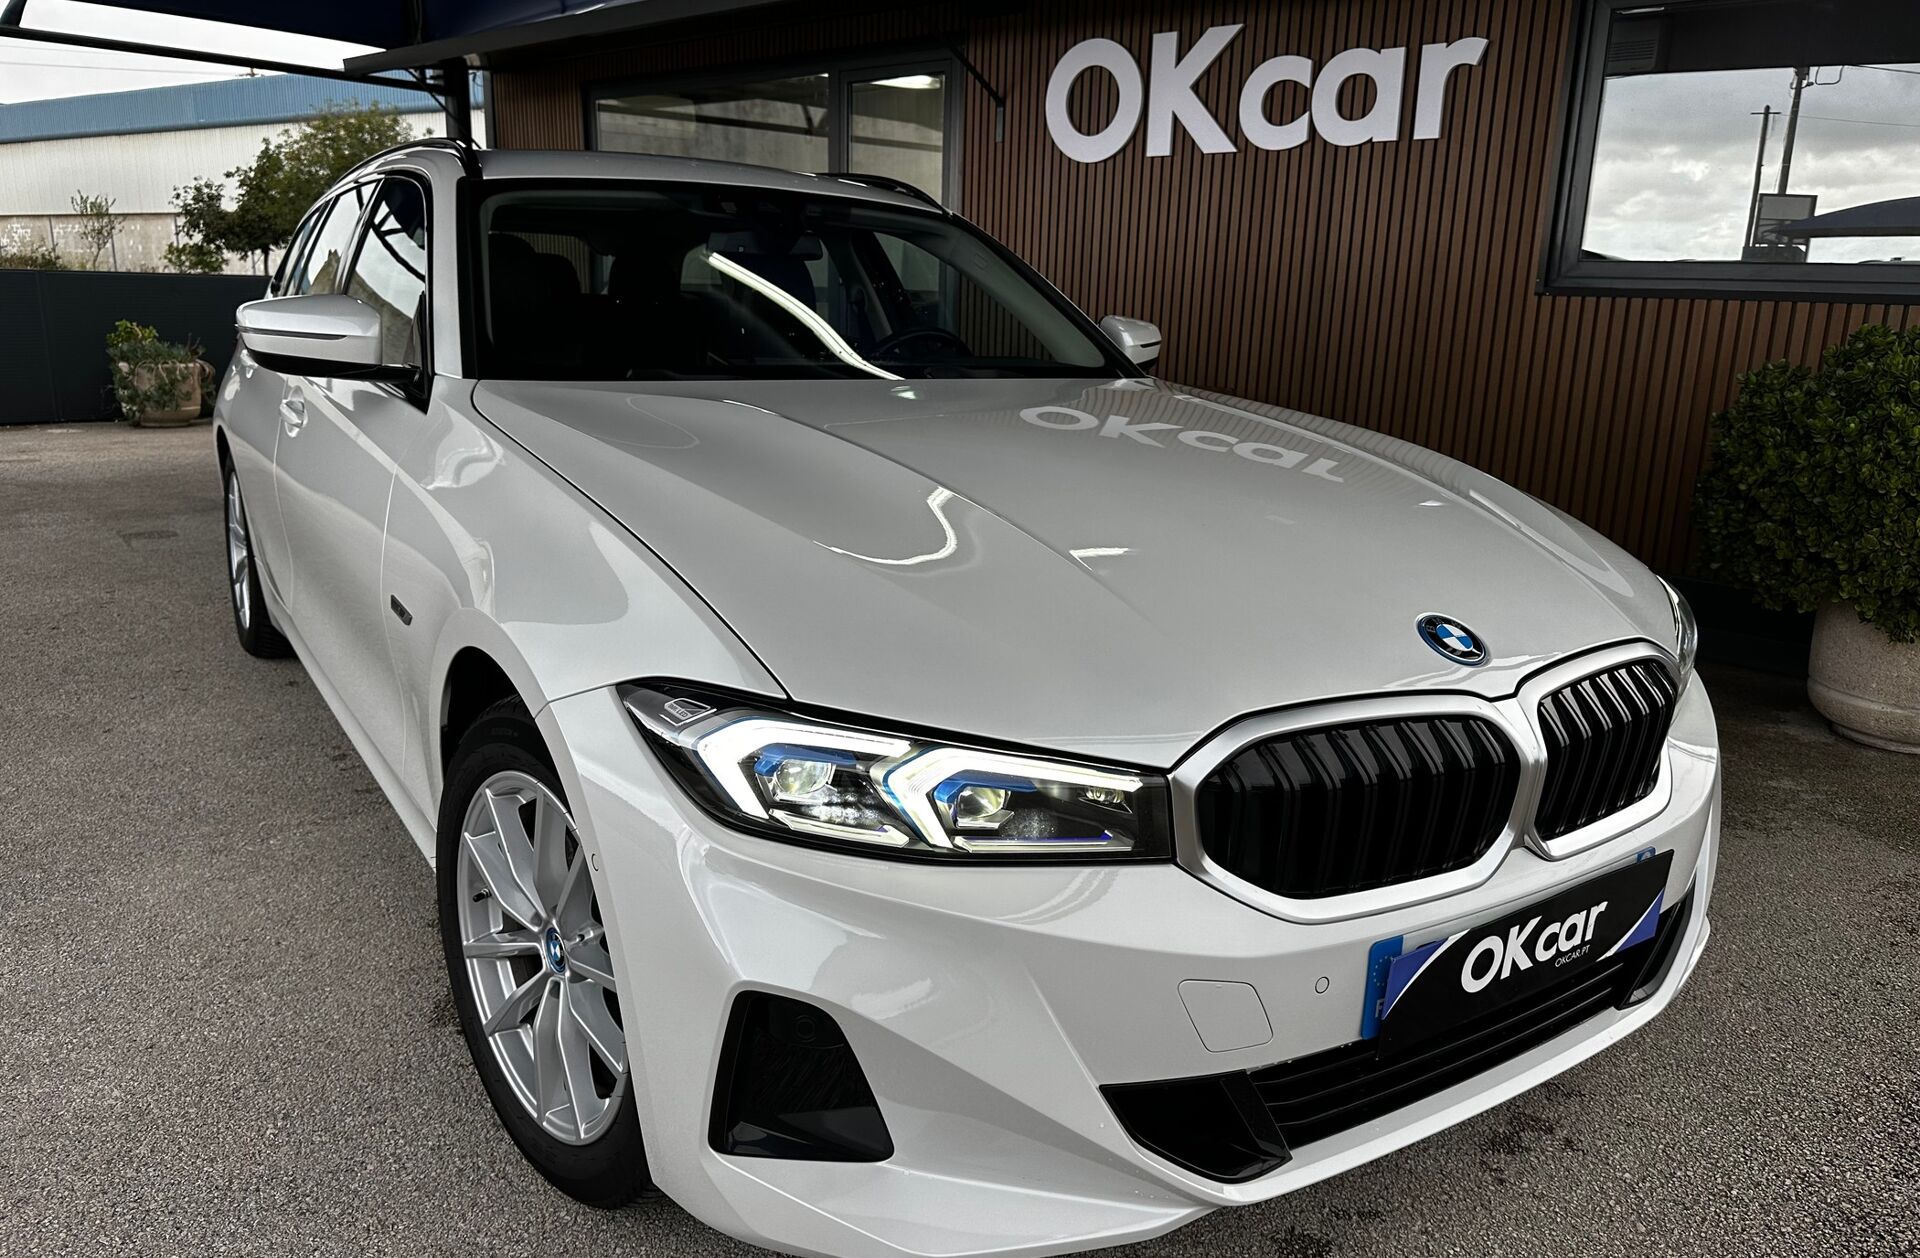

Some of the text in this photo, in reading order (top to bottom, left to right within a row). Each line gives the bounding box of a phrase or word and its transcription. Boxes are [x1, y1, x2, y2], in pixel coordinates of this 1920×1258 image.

[1045, 23, 1489, 163] OKcar
[1461, 901, 1609, 993] OKcar
[1554, 944, 1591, 967] OKCAR.PT
